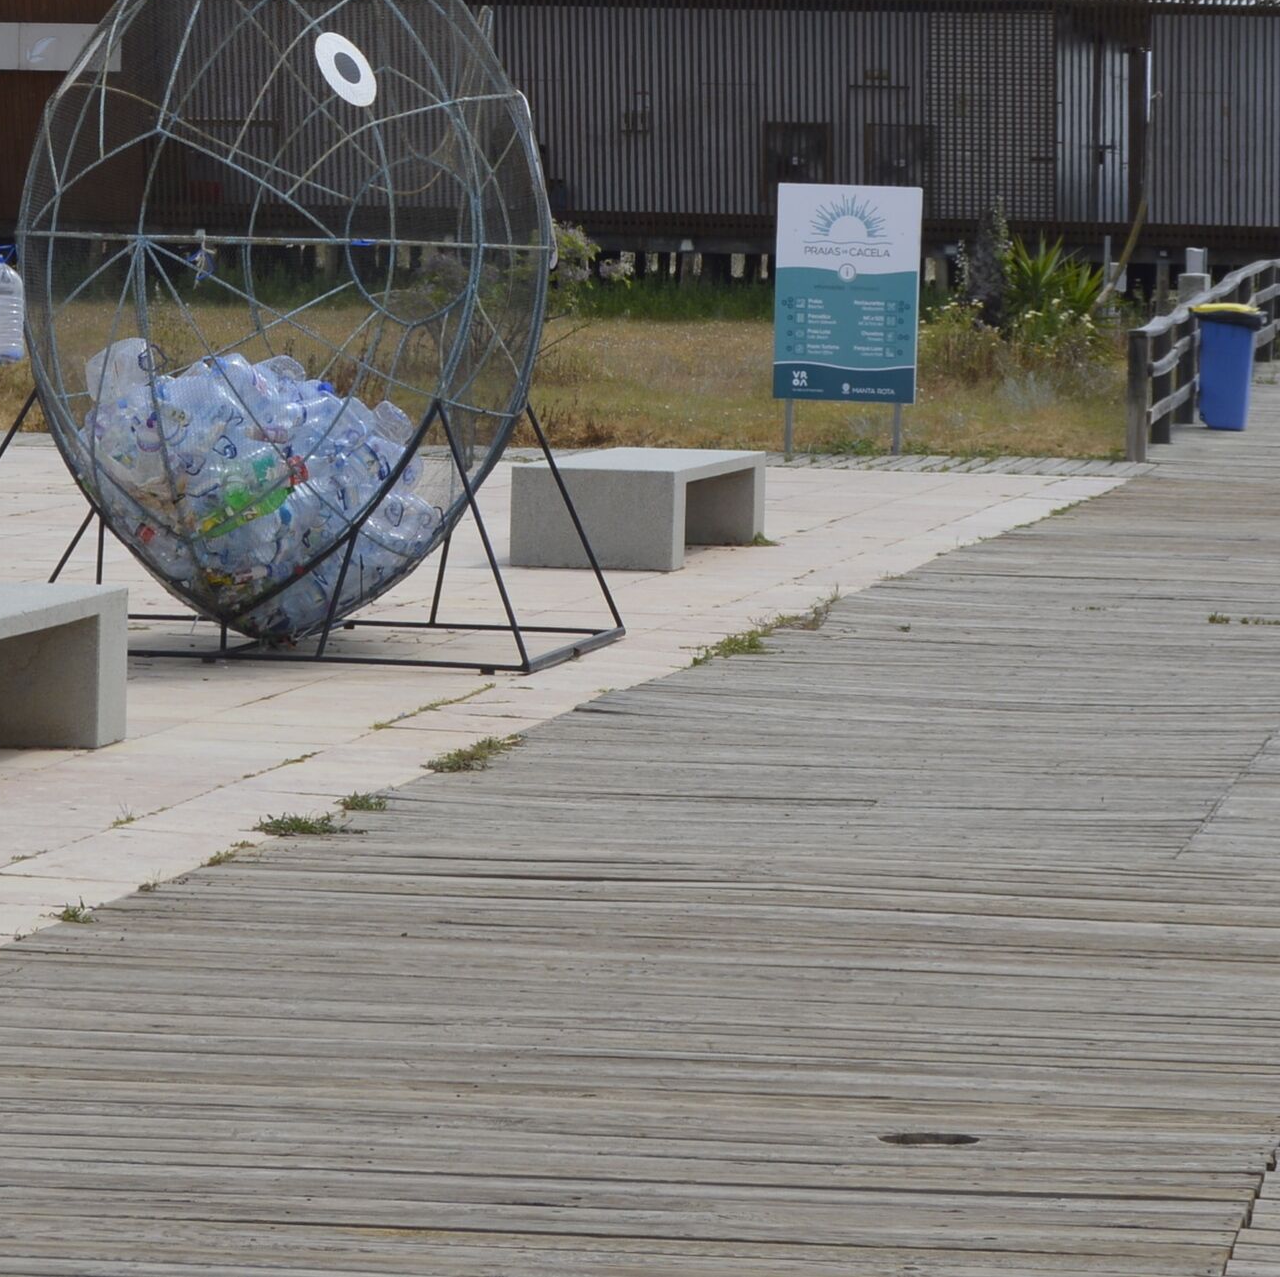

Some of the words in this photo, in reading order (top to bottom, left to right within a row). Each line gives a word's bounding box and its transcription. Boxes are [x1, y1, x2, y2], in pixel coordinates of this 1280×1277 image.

[804, 245, 841, 256] PRAIAS
[849, 247, 891, 258] CACELA
[852, 387, 876, 395] MANTA
[877, 387, 896, 396] ROTA
